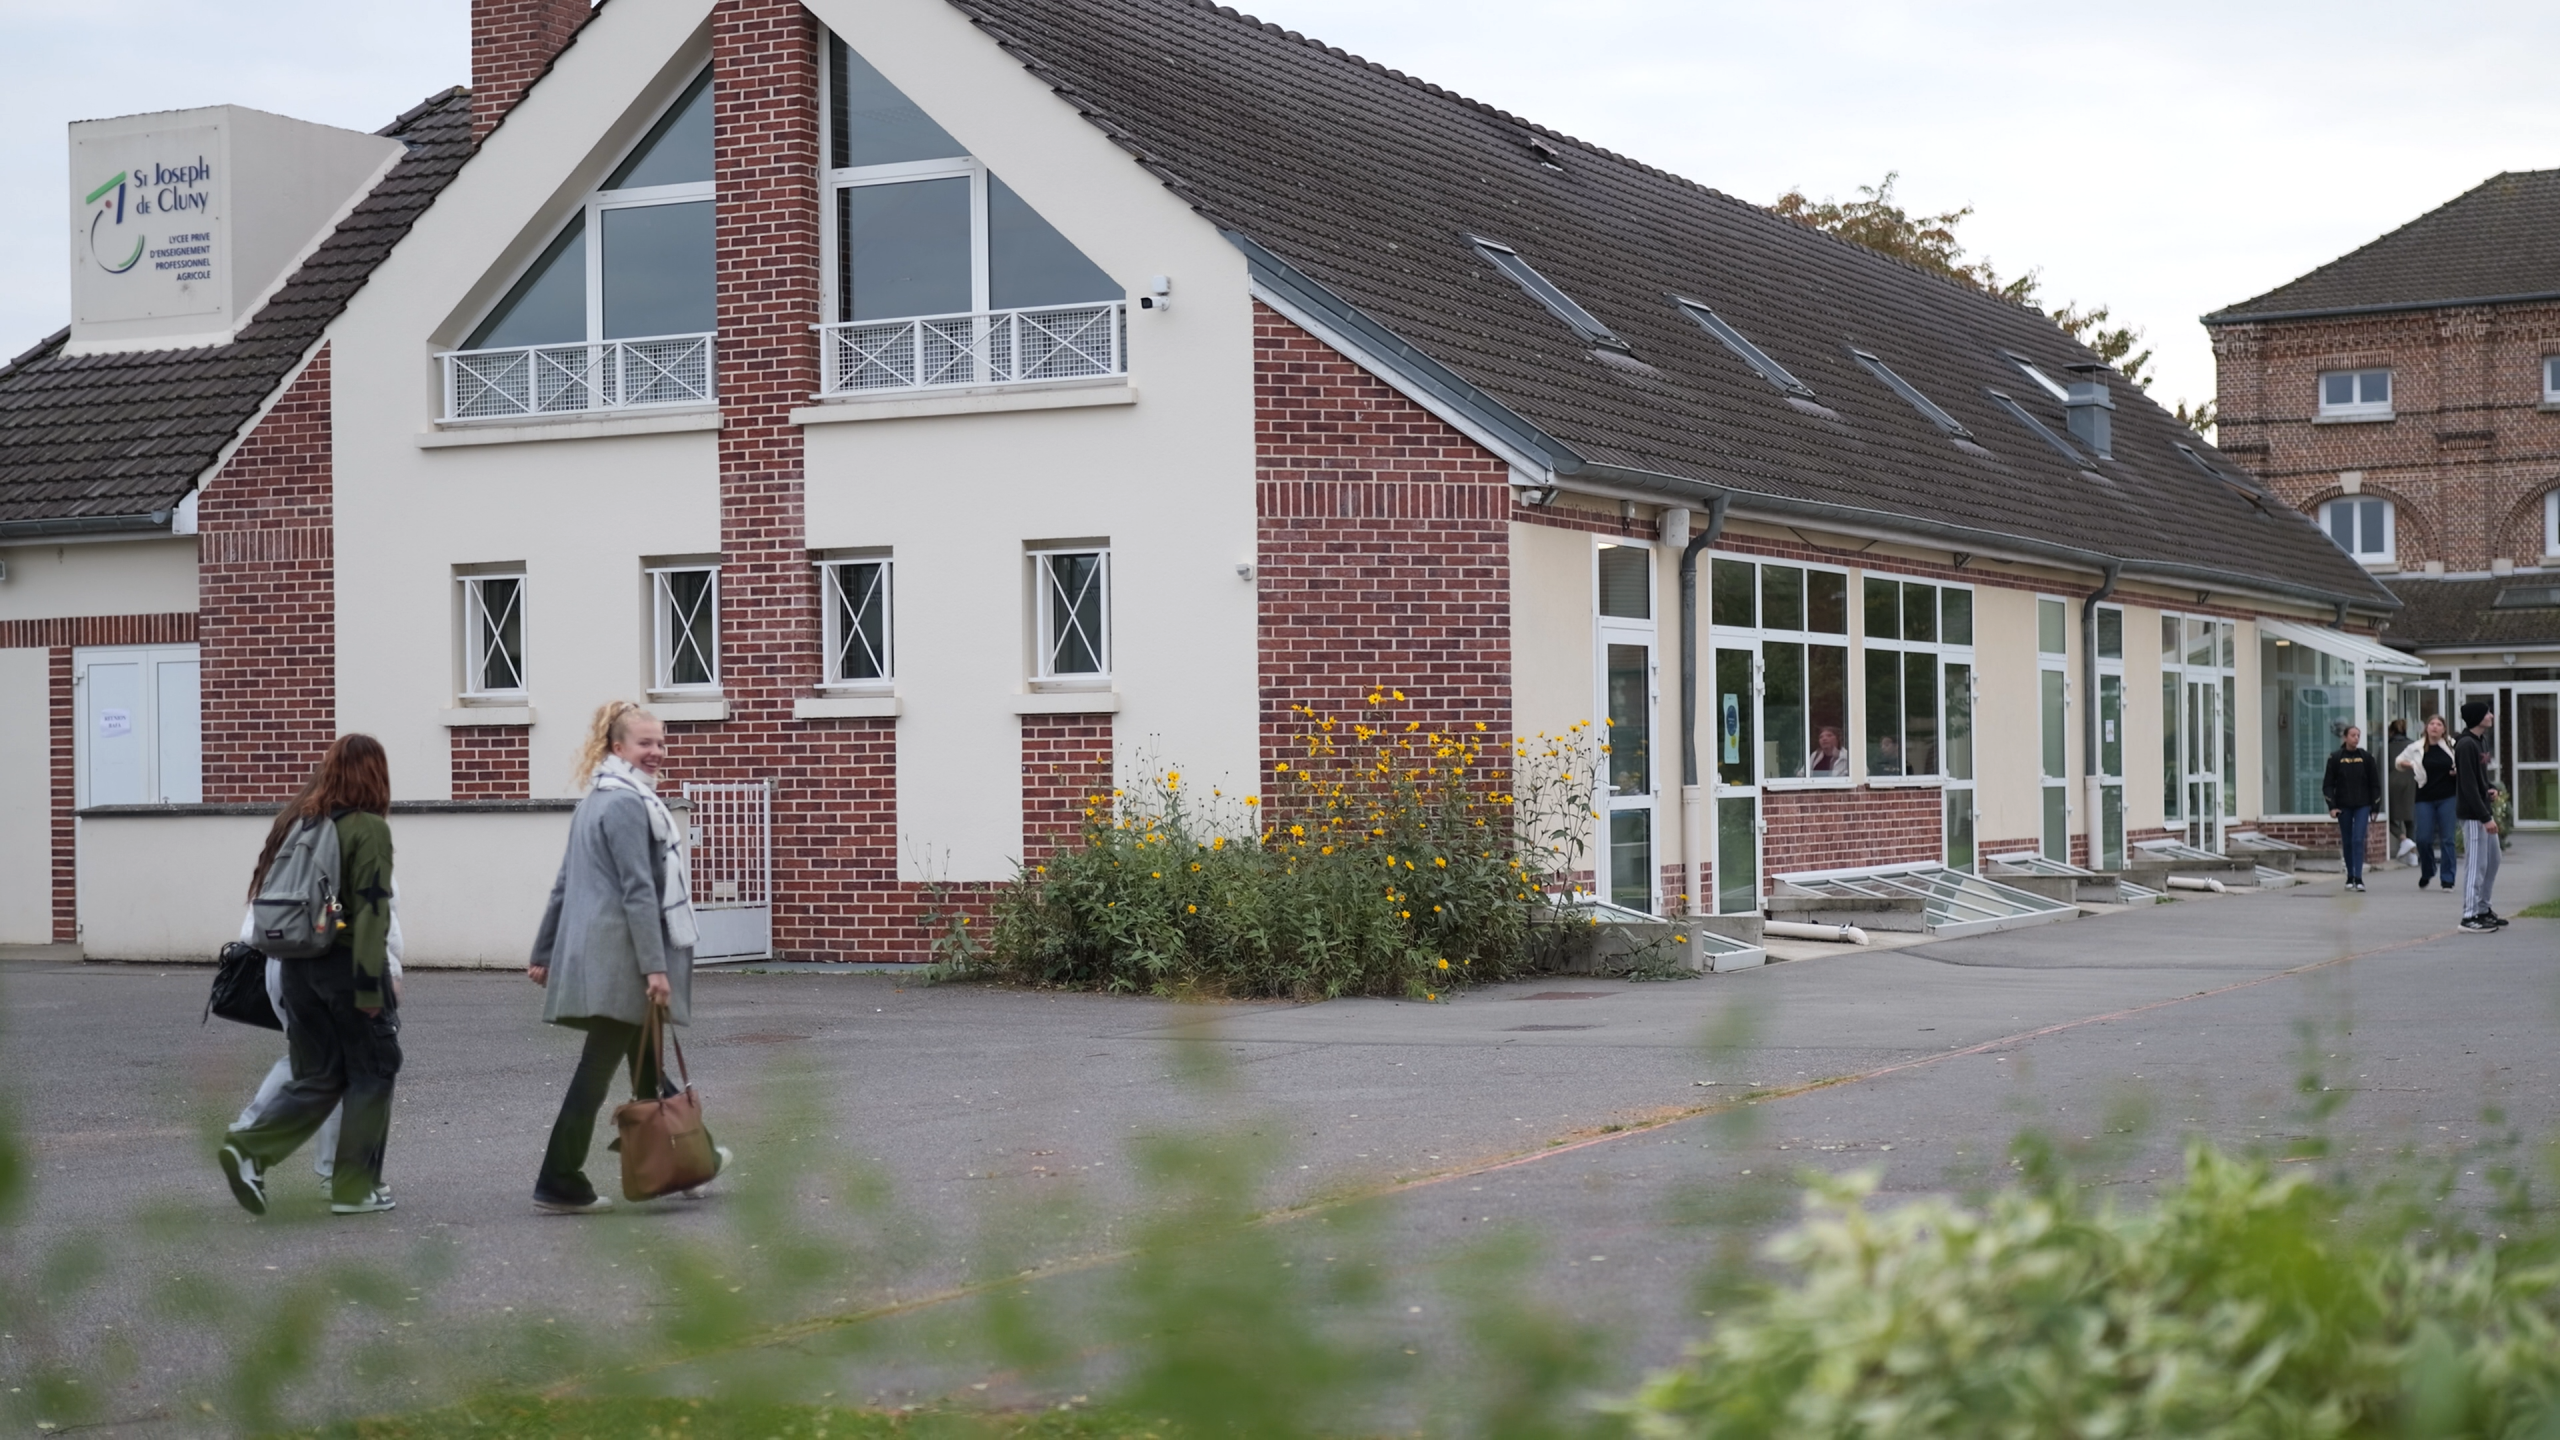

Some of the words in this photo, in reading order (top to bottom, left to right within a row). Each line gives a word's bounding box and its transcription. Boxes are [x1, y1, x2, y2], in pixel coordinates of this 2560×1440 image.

[150, 245, 210, 258] D'ENSEIGNEMENT
[156, 258, 211, 270] PROFESSIONNEL
[177, 270, 211, 281] AGRICOLE
